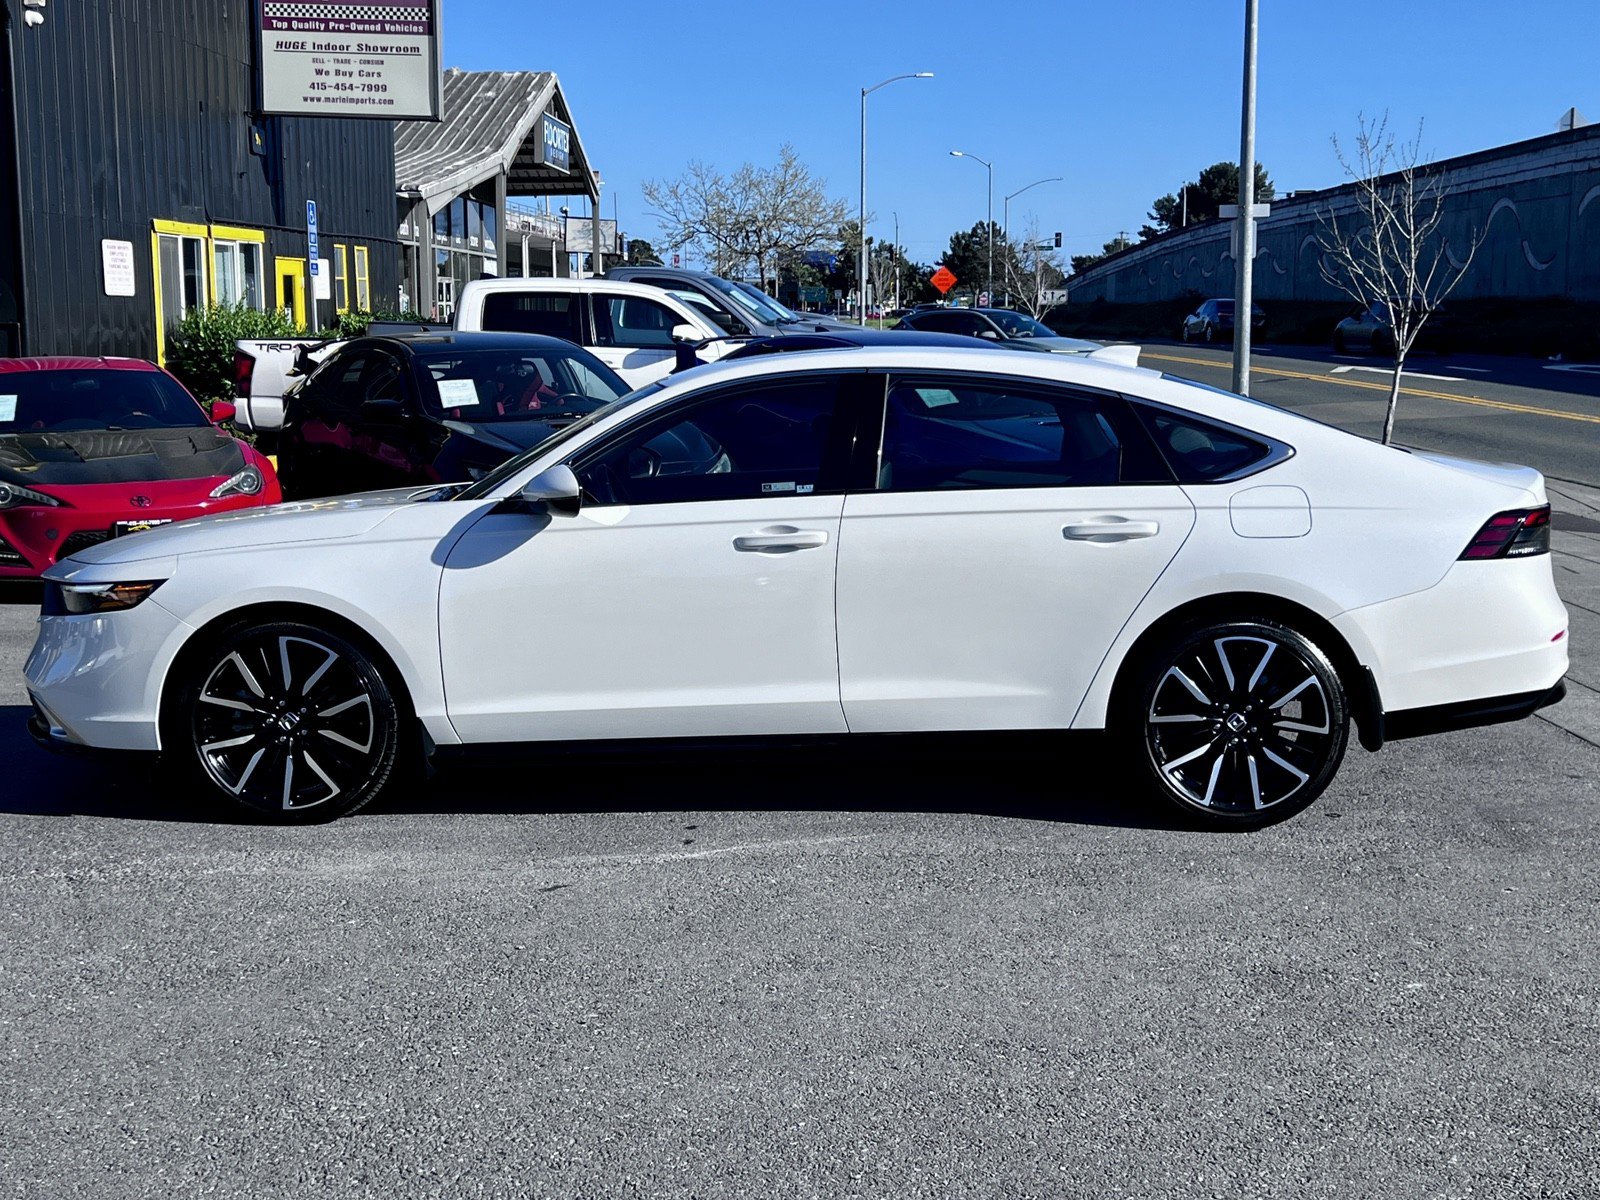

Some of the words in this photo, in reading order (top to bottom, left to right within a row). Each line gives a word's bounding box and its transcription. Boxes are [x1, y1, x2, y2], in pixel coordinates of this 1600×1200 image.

[271, 20, 288, 29] Top
[292, 21, 325, 30] Quality
[329, 22, 381, 31] Pre-Owned
[385, 23, 424, 32] Vehicles
[276, 41, 308, 50] HUGE
[312, 42, 351, 51] Indoor
[357, 43, 420, 53] Showroom
[314, 68, 330, 76] We
[334, 69, 353, 78] Buy
[358, 70, 382, 78] Cars
[309, 82, 387, 92] 415-454-7999
[302, 96, 394, 105] www.marinimports.com
